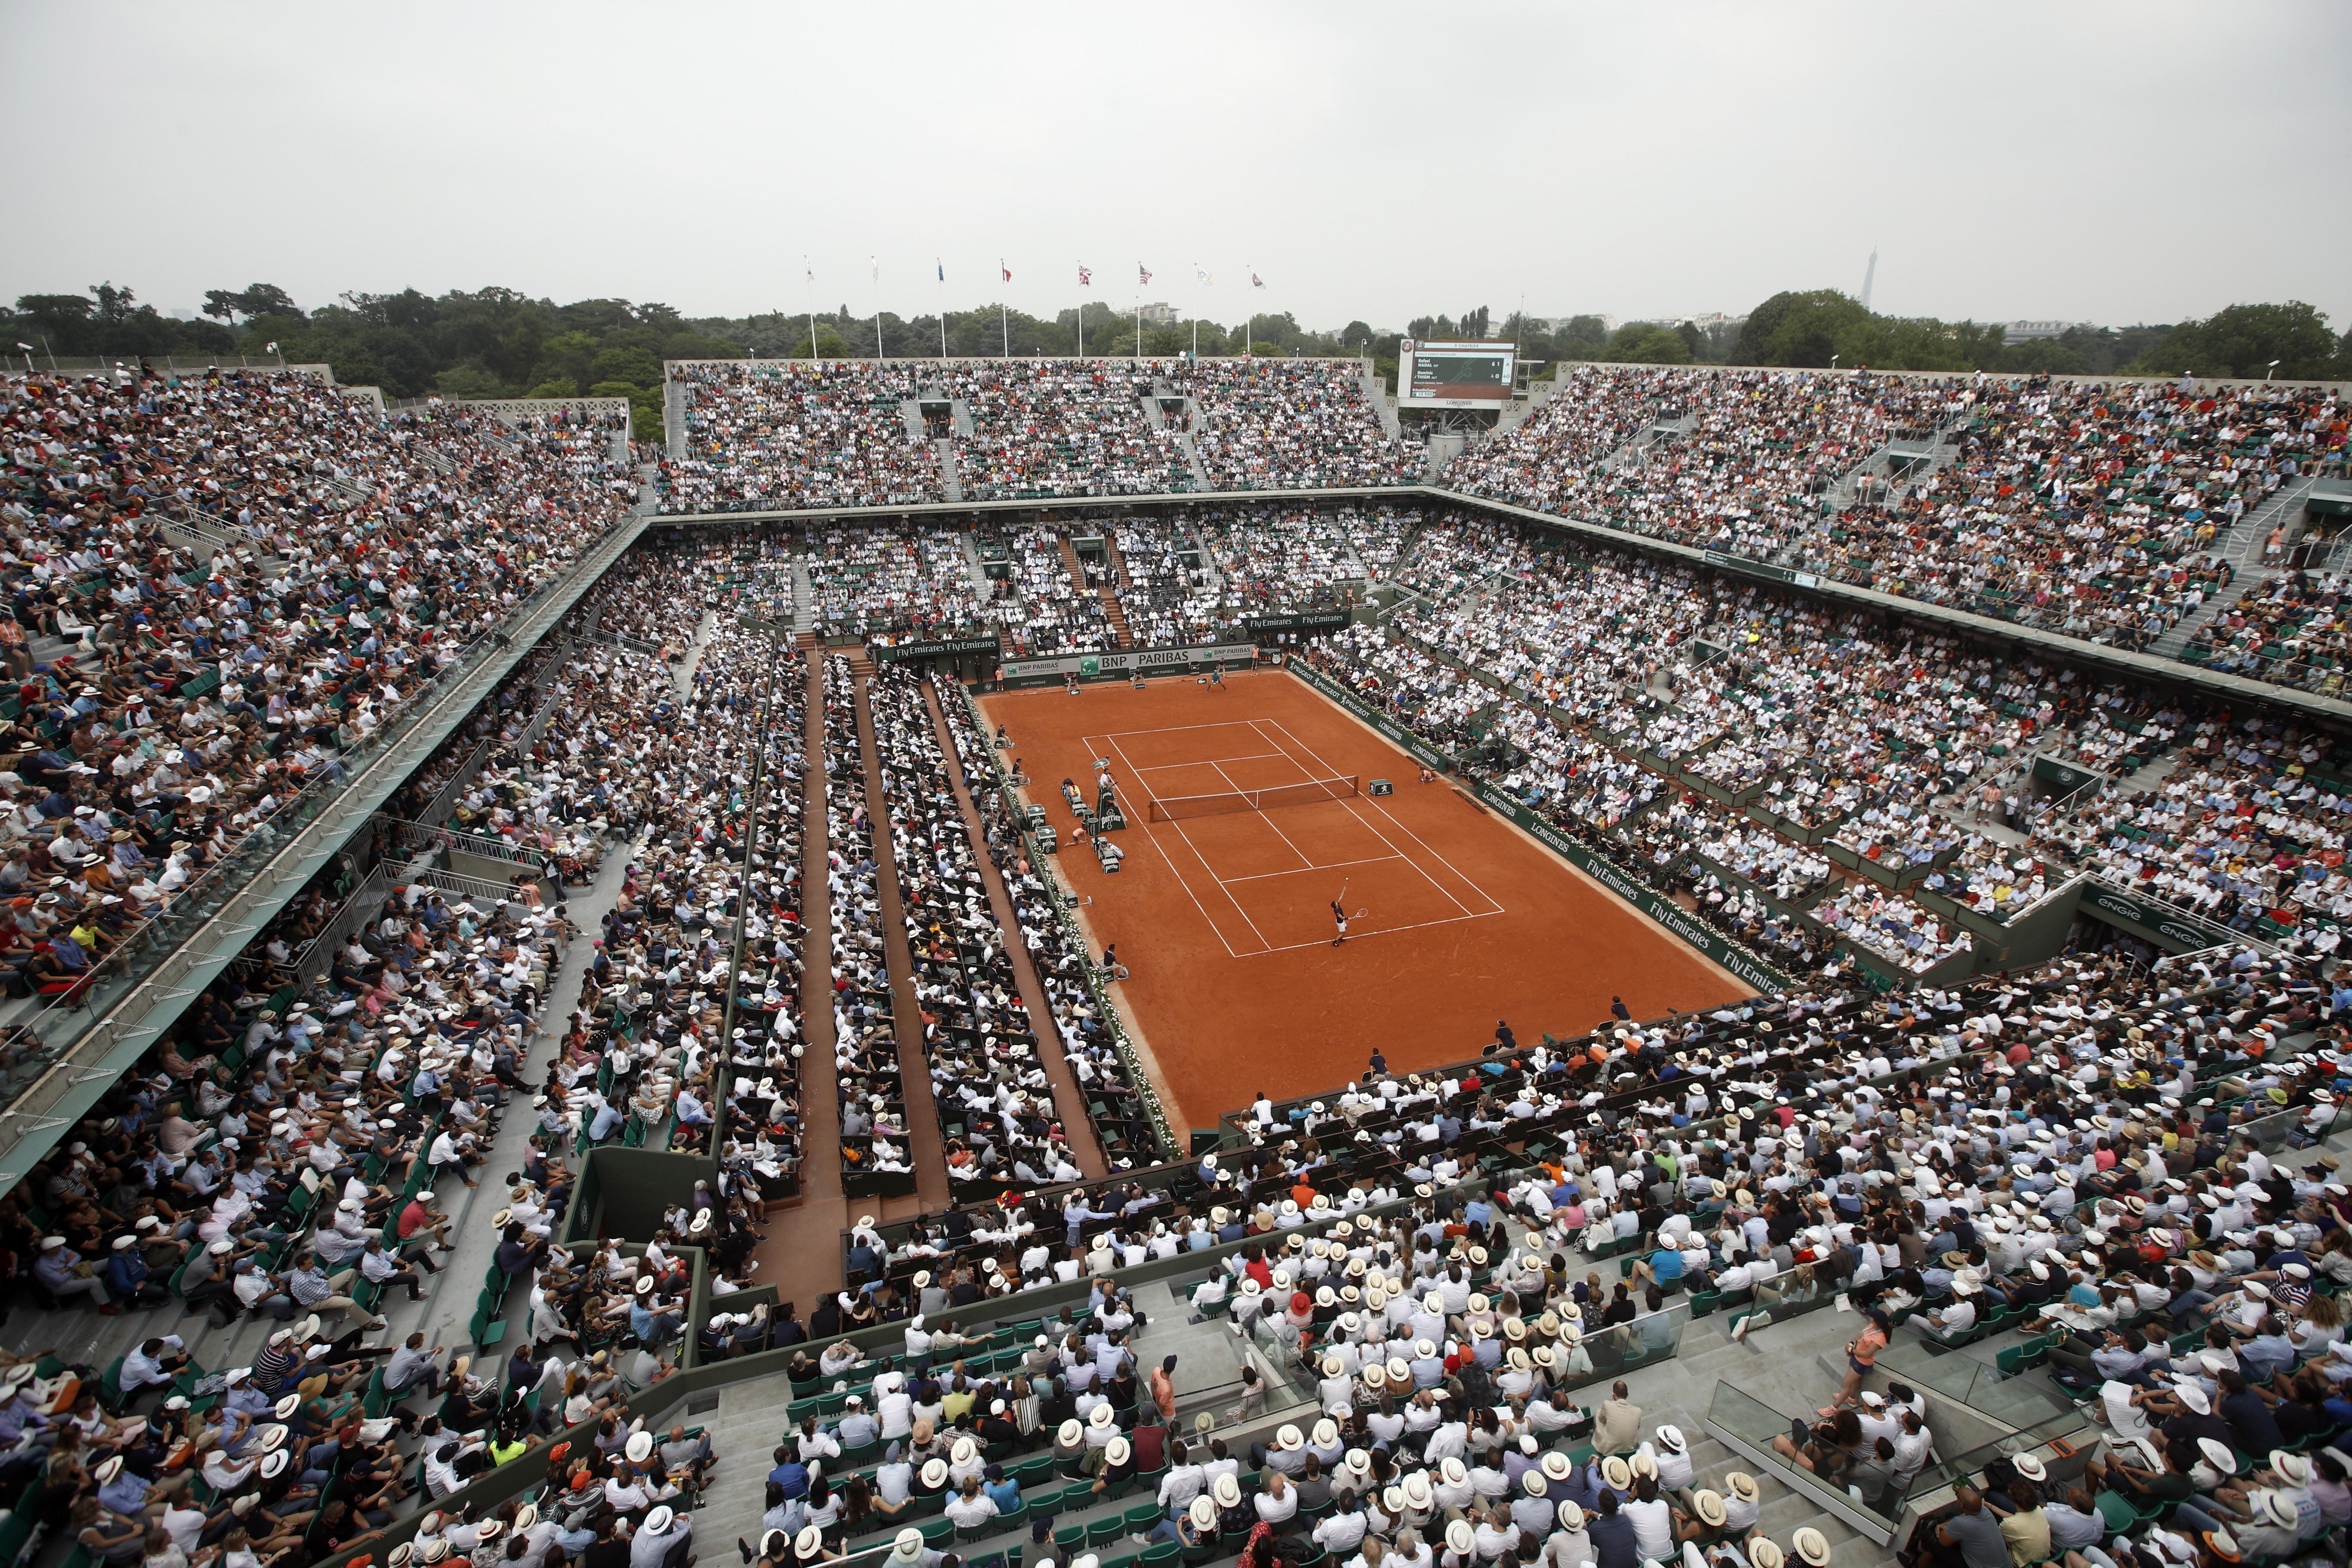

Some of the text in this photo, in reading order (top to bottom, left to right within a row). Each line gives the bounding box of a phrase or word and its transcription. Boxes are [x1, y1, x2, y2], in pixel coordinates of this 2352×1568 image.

[1250, 618, 1292, 628] Fly Emirates
[1302, 615, 1343, 625] Fly Emirates
[897, 644, 944, 657] Fly Emirates
[946, 640, 996, 651] Fly Emirates
[1102, 651, 1188, 668] BNP PARIBAS
[1293, 665, 1314, 681] PEUGEOT
[1318, 682, 1340, 698] PEUGEOT
[1345, 699, 1370, 718] PEUGEOT
[1378, 720, 1403, 741] LONGINES
[1411, 742, 1439, 765] LONGINES
[1482, 790, 1516, 817] LONGINES
[1101, 813, 1121, 829] perrier
[1531, 822, 1569, 853] LONGINES
[1586, 858, 1638, 900] Fly Emirates
[1650, 901, 1710, 949] Fly Emirates
[1723, 950, 1744, 974] Fly
